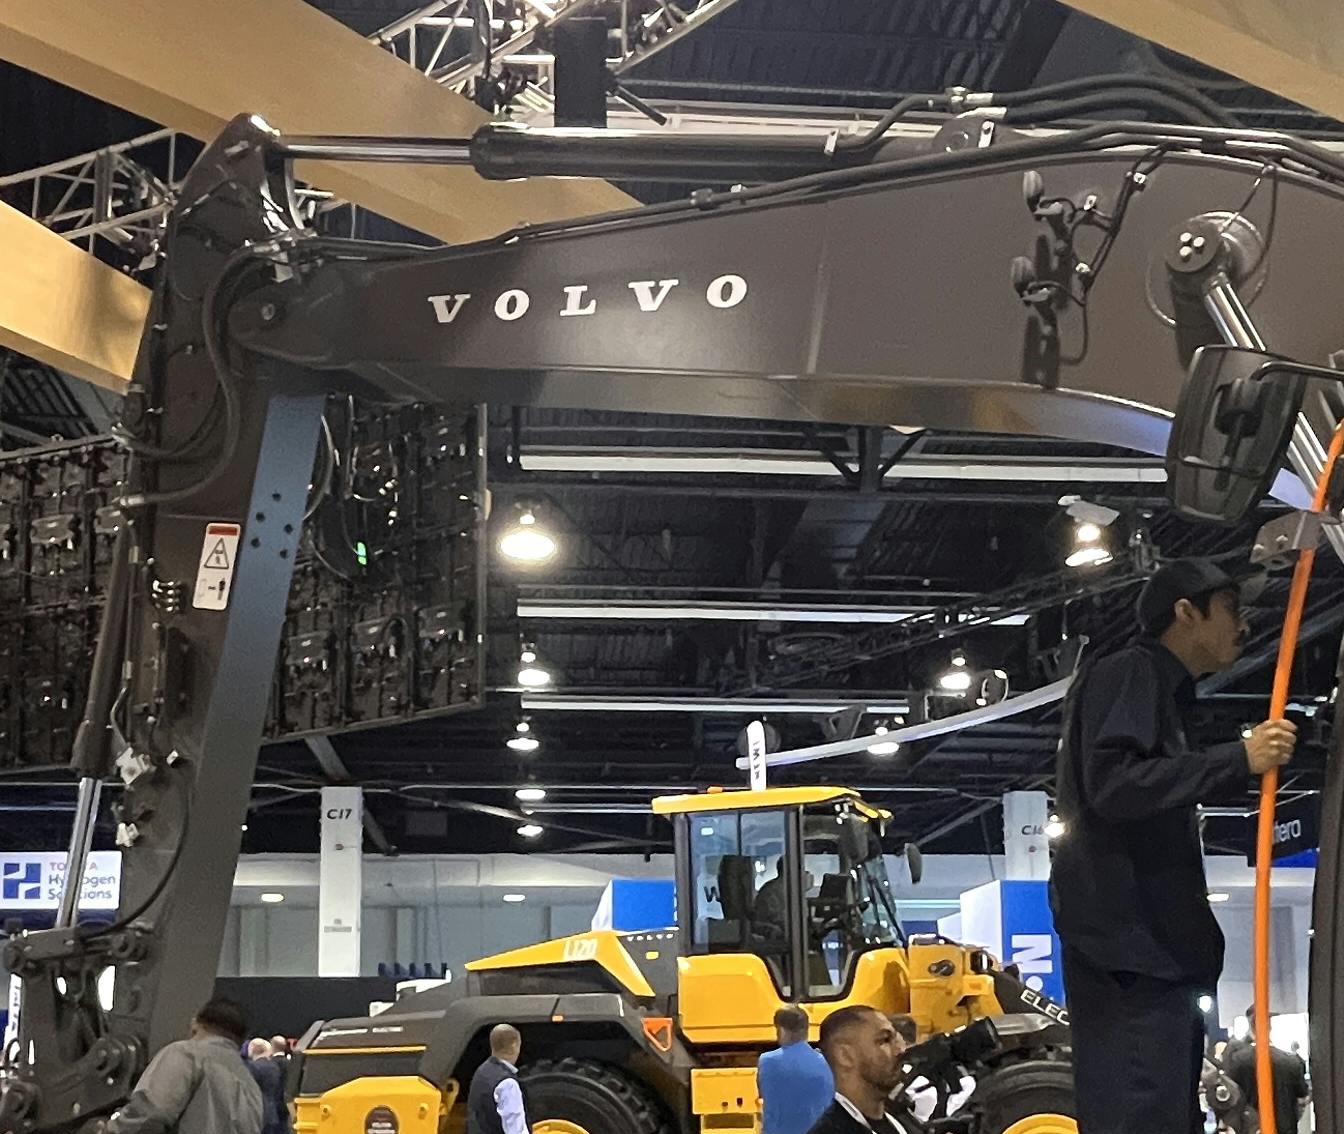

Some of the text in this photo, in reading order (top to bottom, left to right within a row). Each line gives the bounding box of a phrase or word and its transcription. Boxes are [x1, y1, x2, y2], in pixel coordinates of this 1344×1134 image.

[427, 273, 748, 323] VOLVO
[326, 808, 353, 820] C17
[49, 862, 98, 871] TOA
[48, 873, 116, 888] Hyogen
[47, 888, 113, 901] Soions
[563, 938, 599, 961] L120
[1019, 988, 1071, 1026] ELEC
